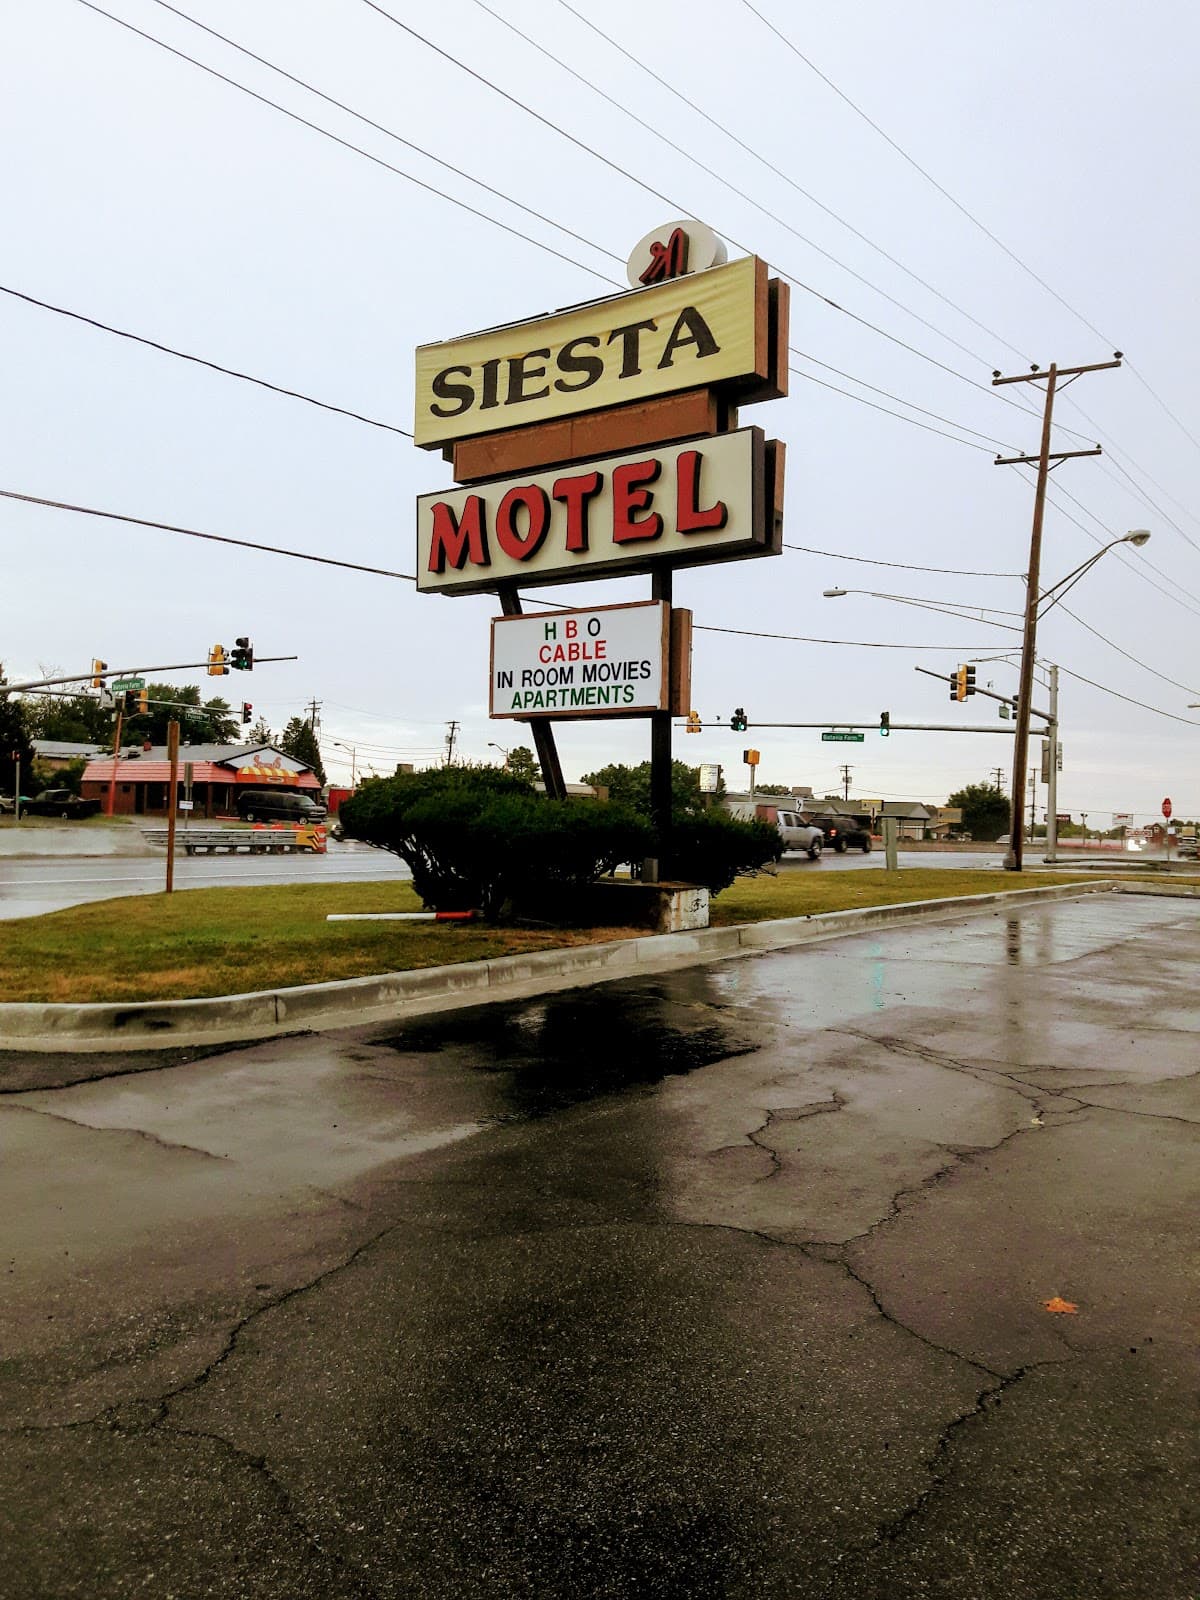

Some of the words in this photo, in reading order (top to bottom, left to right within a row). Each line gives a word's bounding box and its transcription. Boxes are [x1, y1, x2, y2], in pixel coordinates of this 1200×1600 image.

[429, 306, 721, 418] SIESTA
[427, 450, 728, 574] MOTEL
[539, 640, 607, 663] CABLE
[497, 671, 513, 688] IN
[522, 666, 574, 688] ROOM
[582, 660, 652, 683] MOVIES
[511, 684, 635, 710] APARTMENTS
